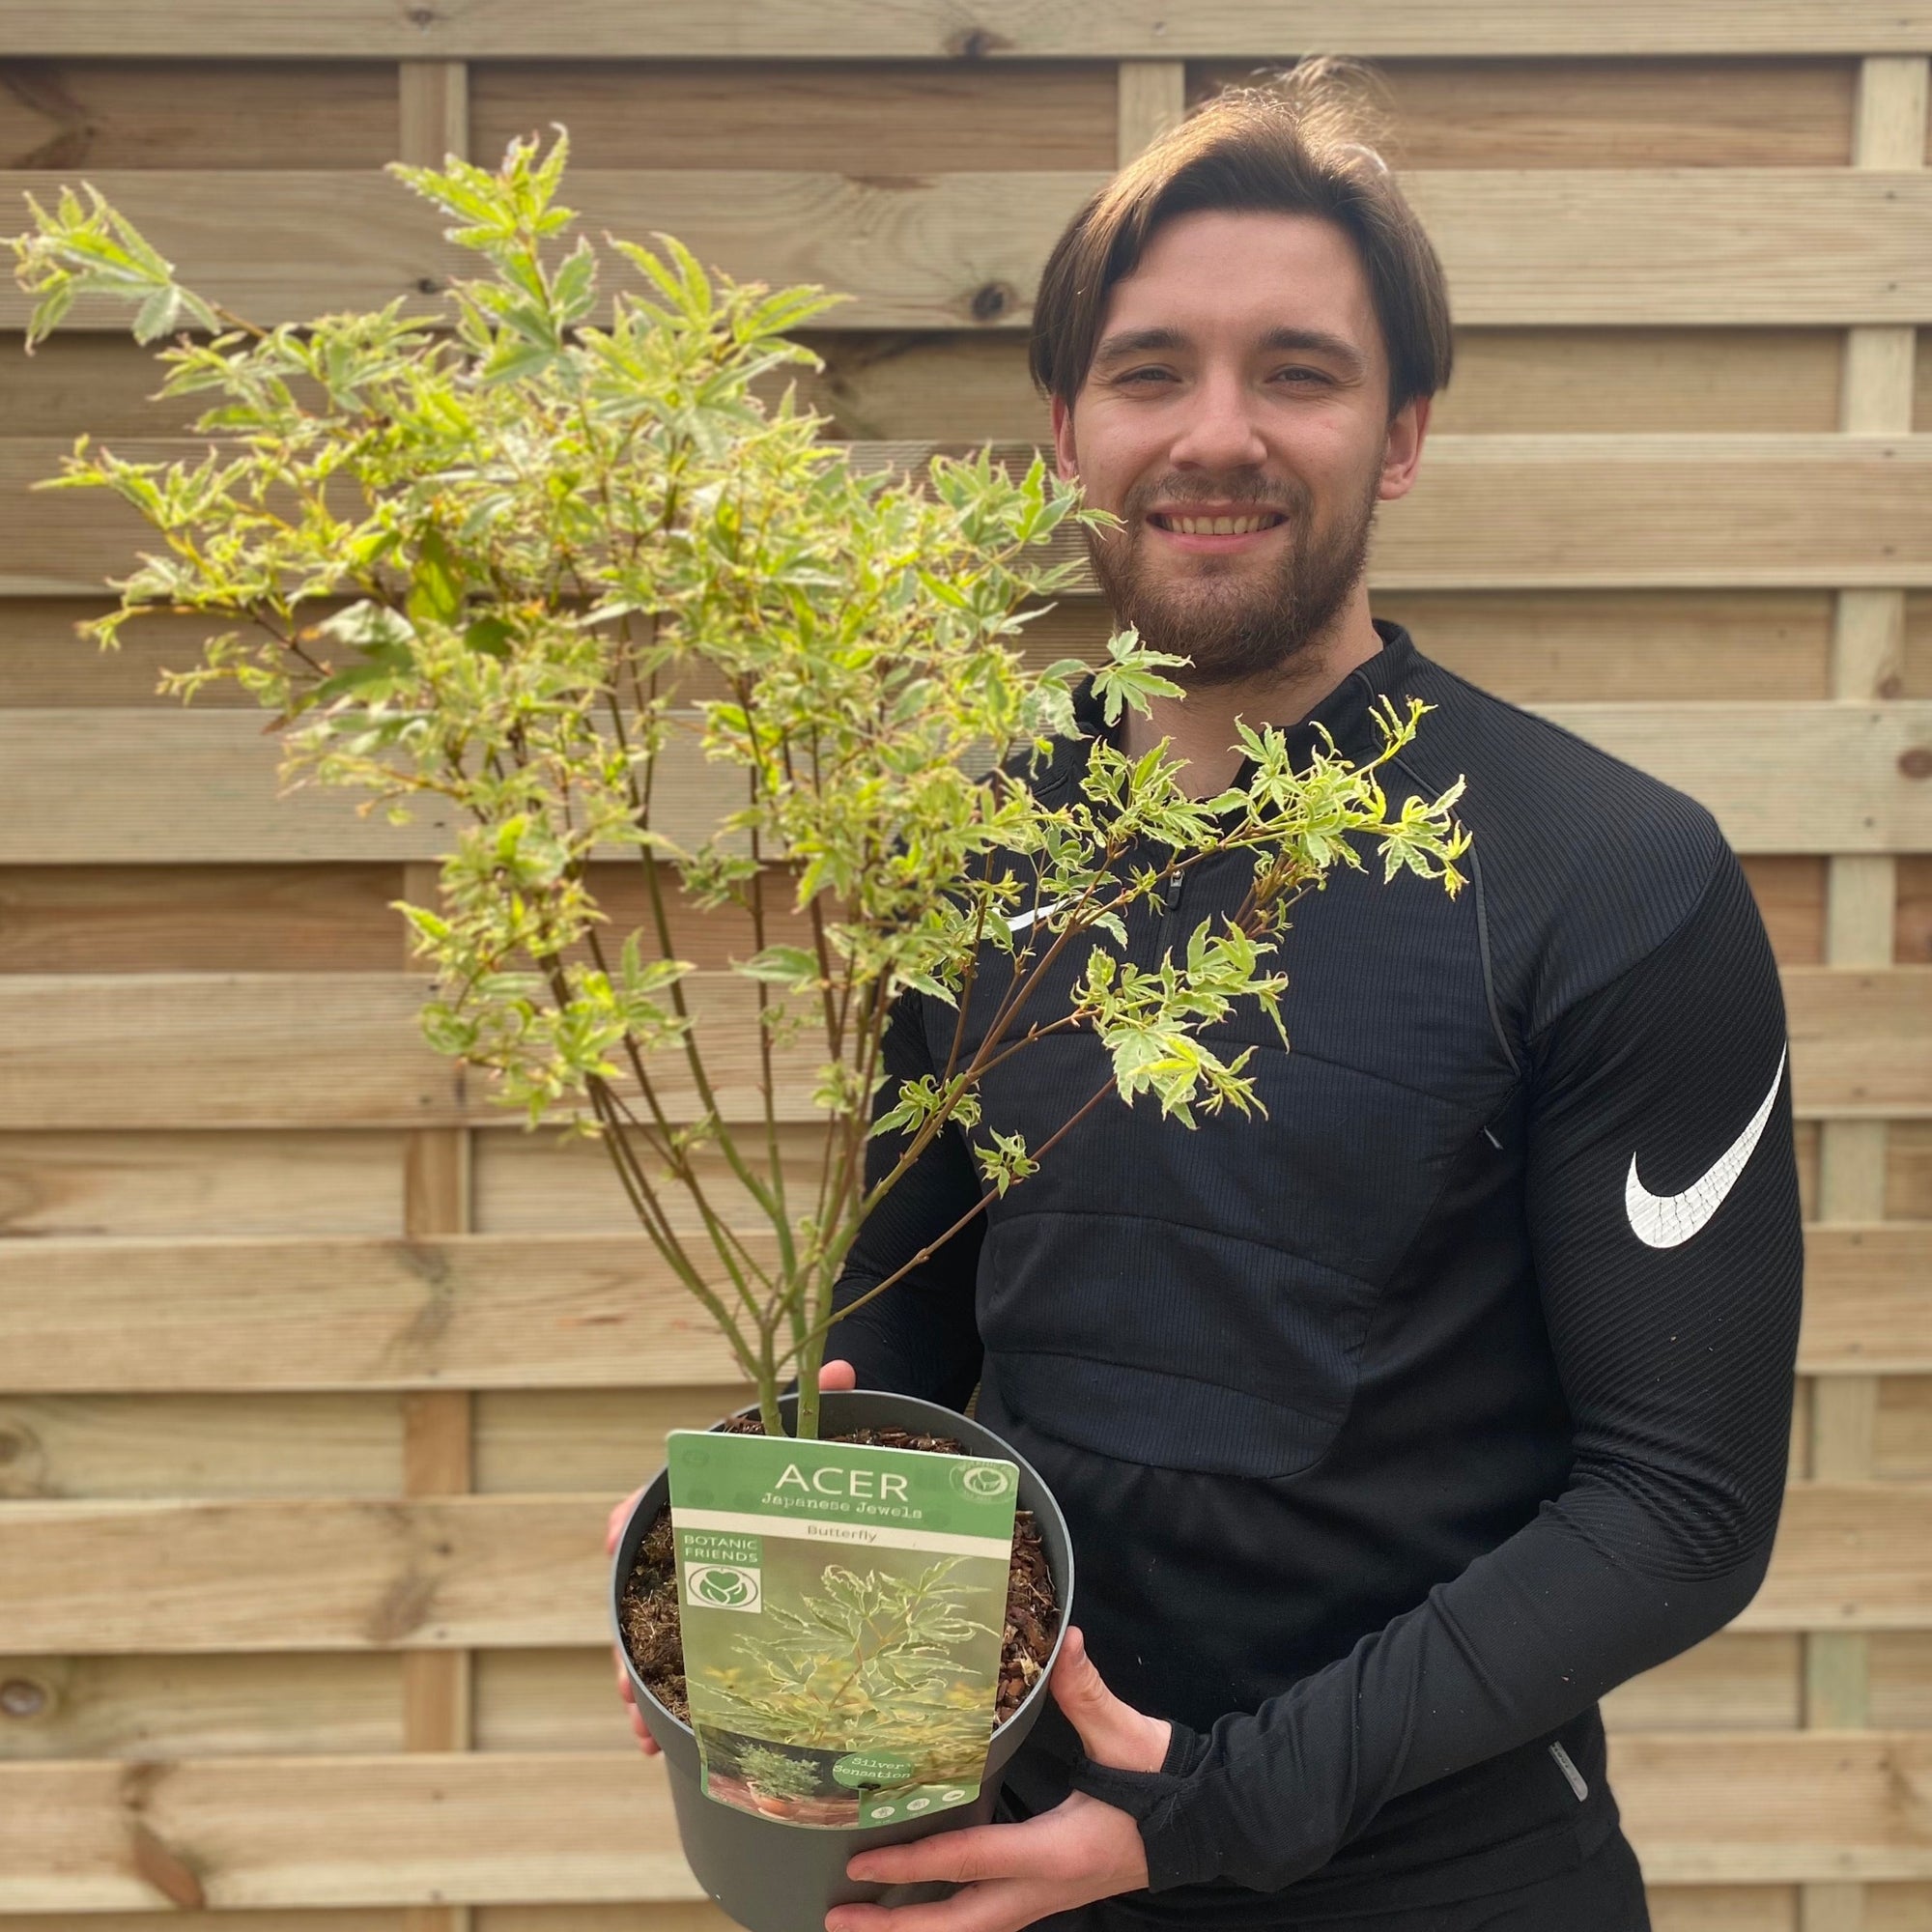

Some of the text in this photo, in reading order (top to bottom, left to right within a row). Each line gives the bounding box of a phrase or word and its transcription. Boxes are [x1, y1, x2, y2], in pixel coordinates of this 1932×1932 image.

[776, 1463, 909, 1501] ACER
[762, 1492, 923, 1519] Japanese Jewels
[807, 1525, 877, 1543] Butterfly
[683, 1535, 757, 1549] BOTANIC
[684, 1548, 758, 1563] FRIENDS
[851, 1756, 904, 1770] Silver
[833, 1765, 911, 1778] Sensation
